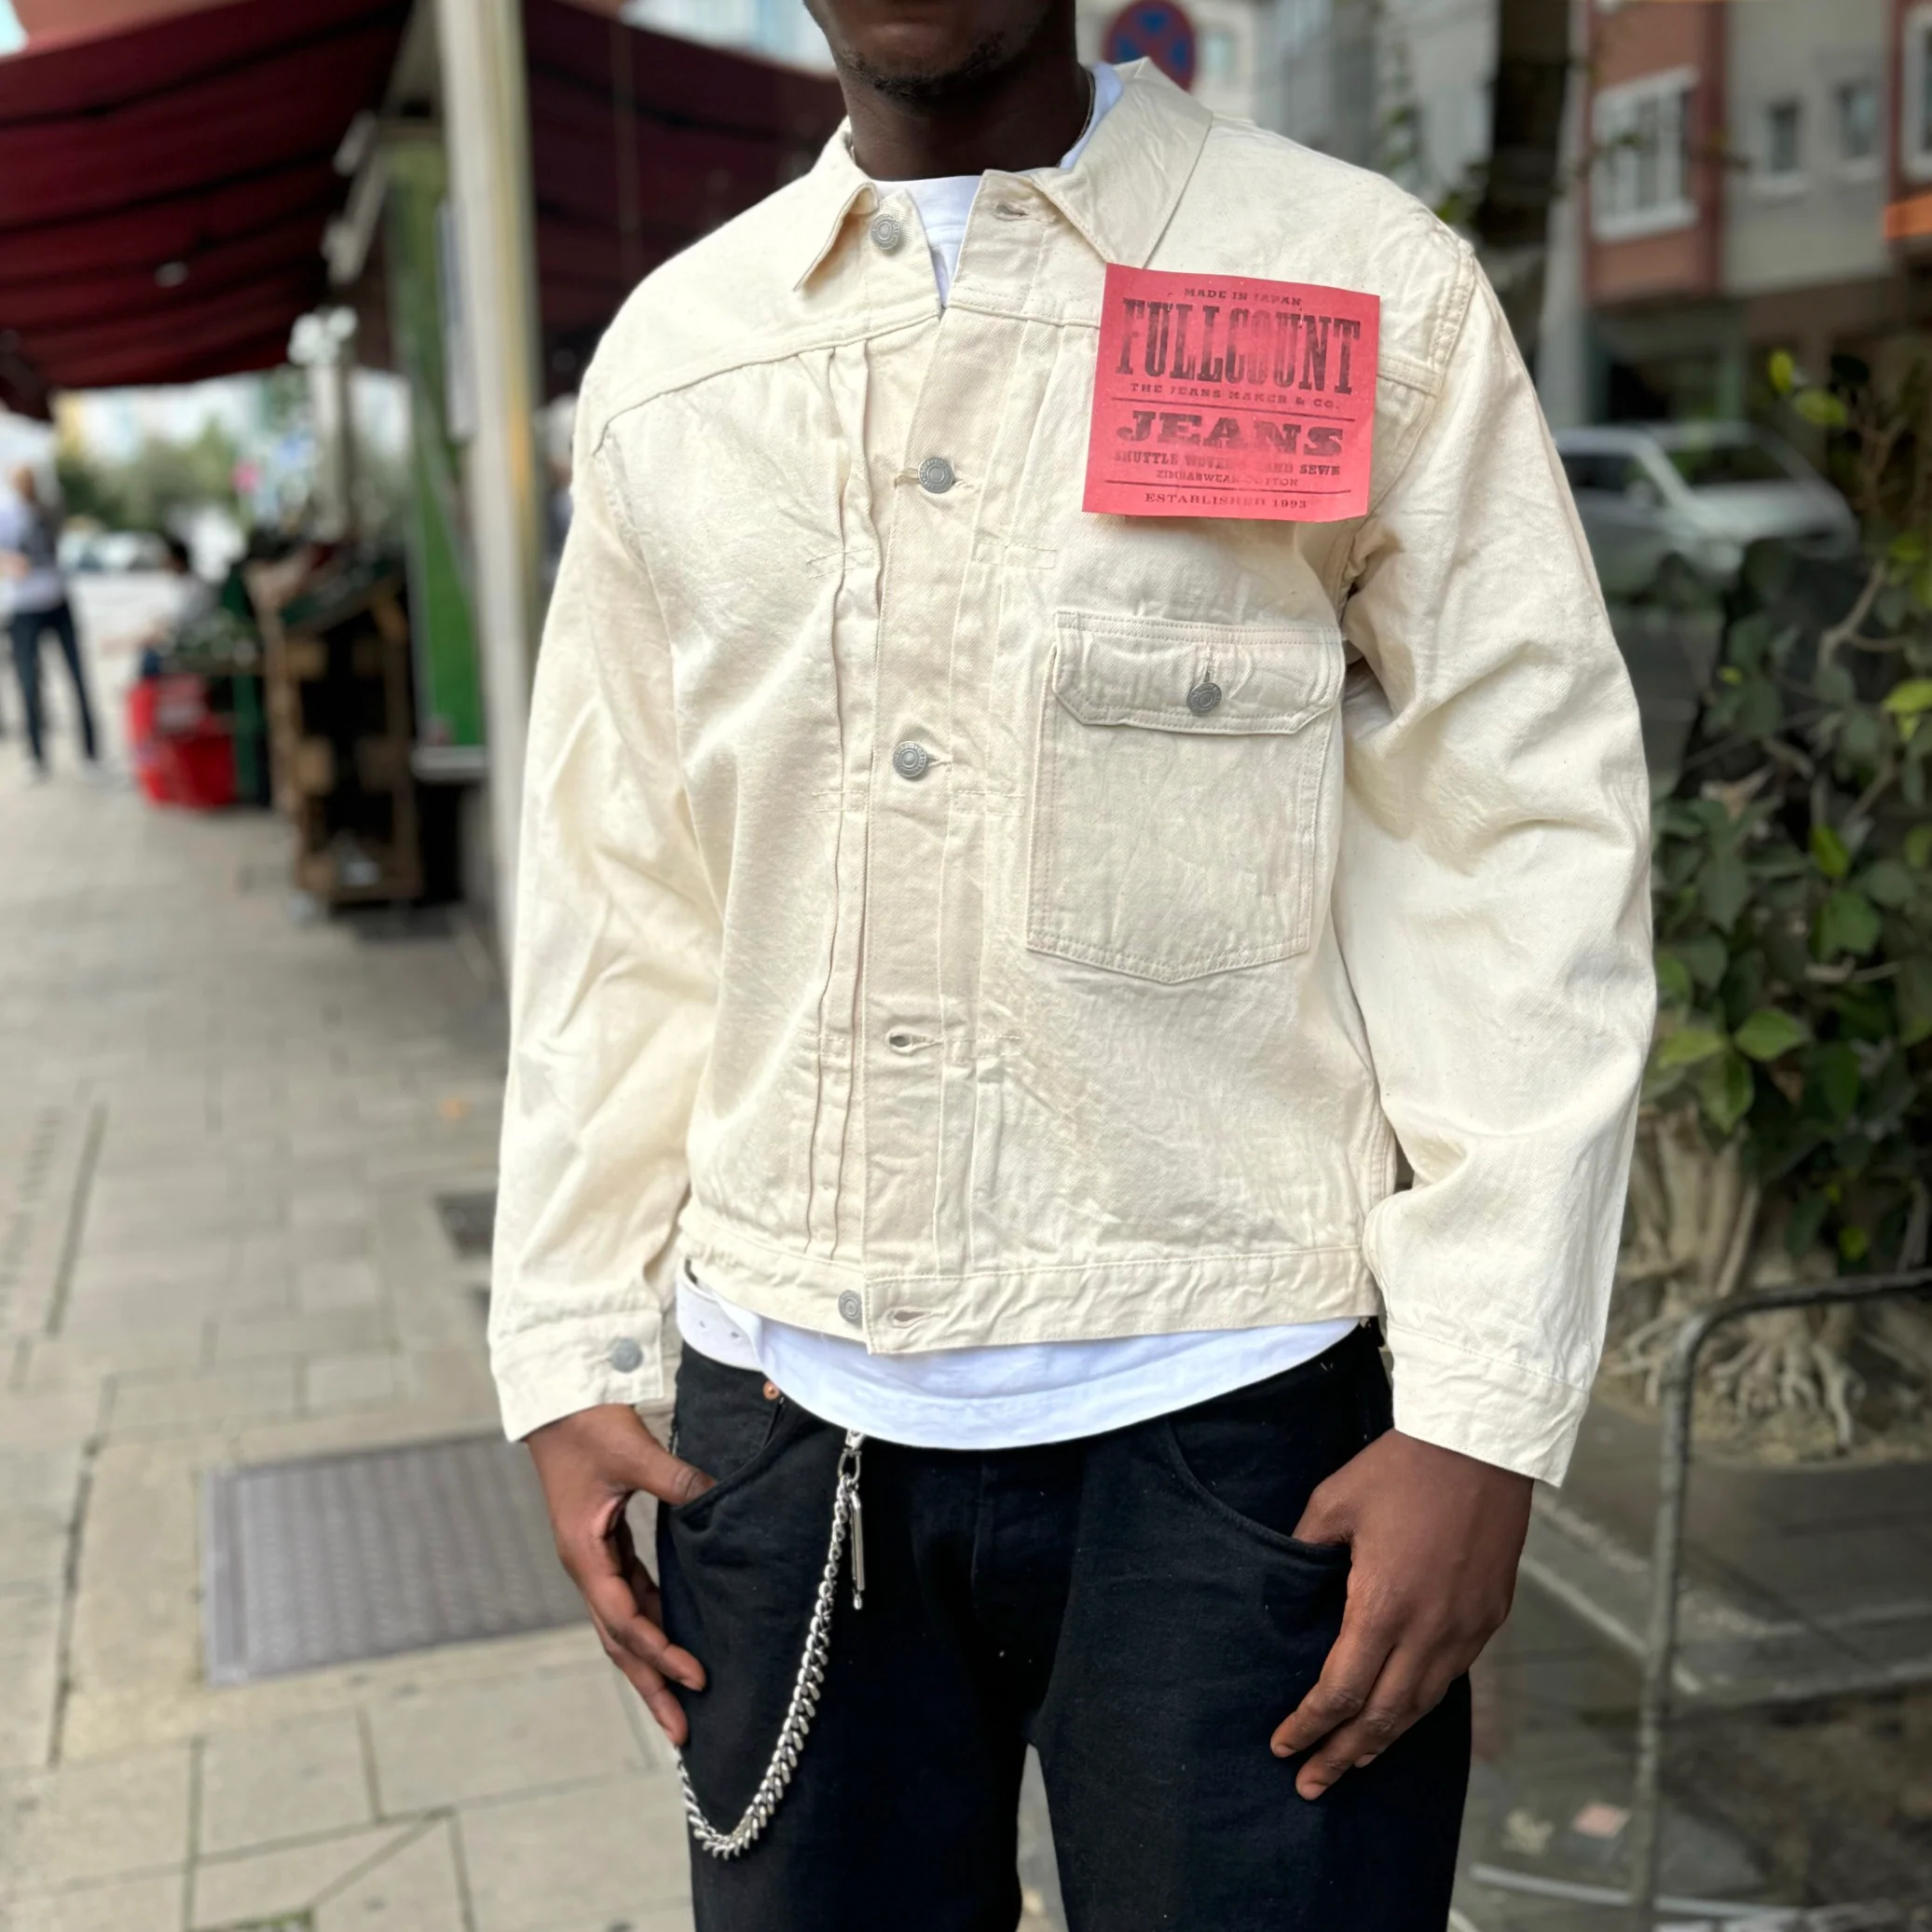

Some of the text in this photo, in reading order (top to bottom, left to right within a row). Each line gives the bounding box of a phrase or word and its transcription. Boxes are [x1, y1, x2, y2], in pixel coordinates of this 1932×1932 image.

[1185, 288, 1302, 306] MADE IN JAPAN
[1116, 297, 1361, 394] FULLCOUNT
[1130, 383, 1340, 409] THE JEANS MAKER & CO.
[1116, 410, 1343, 457] JEANS
[1114, 449, 1179, 466] SHUTTLE
[1144, 492, 1307, 509] ESTABLISHED 1993
